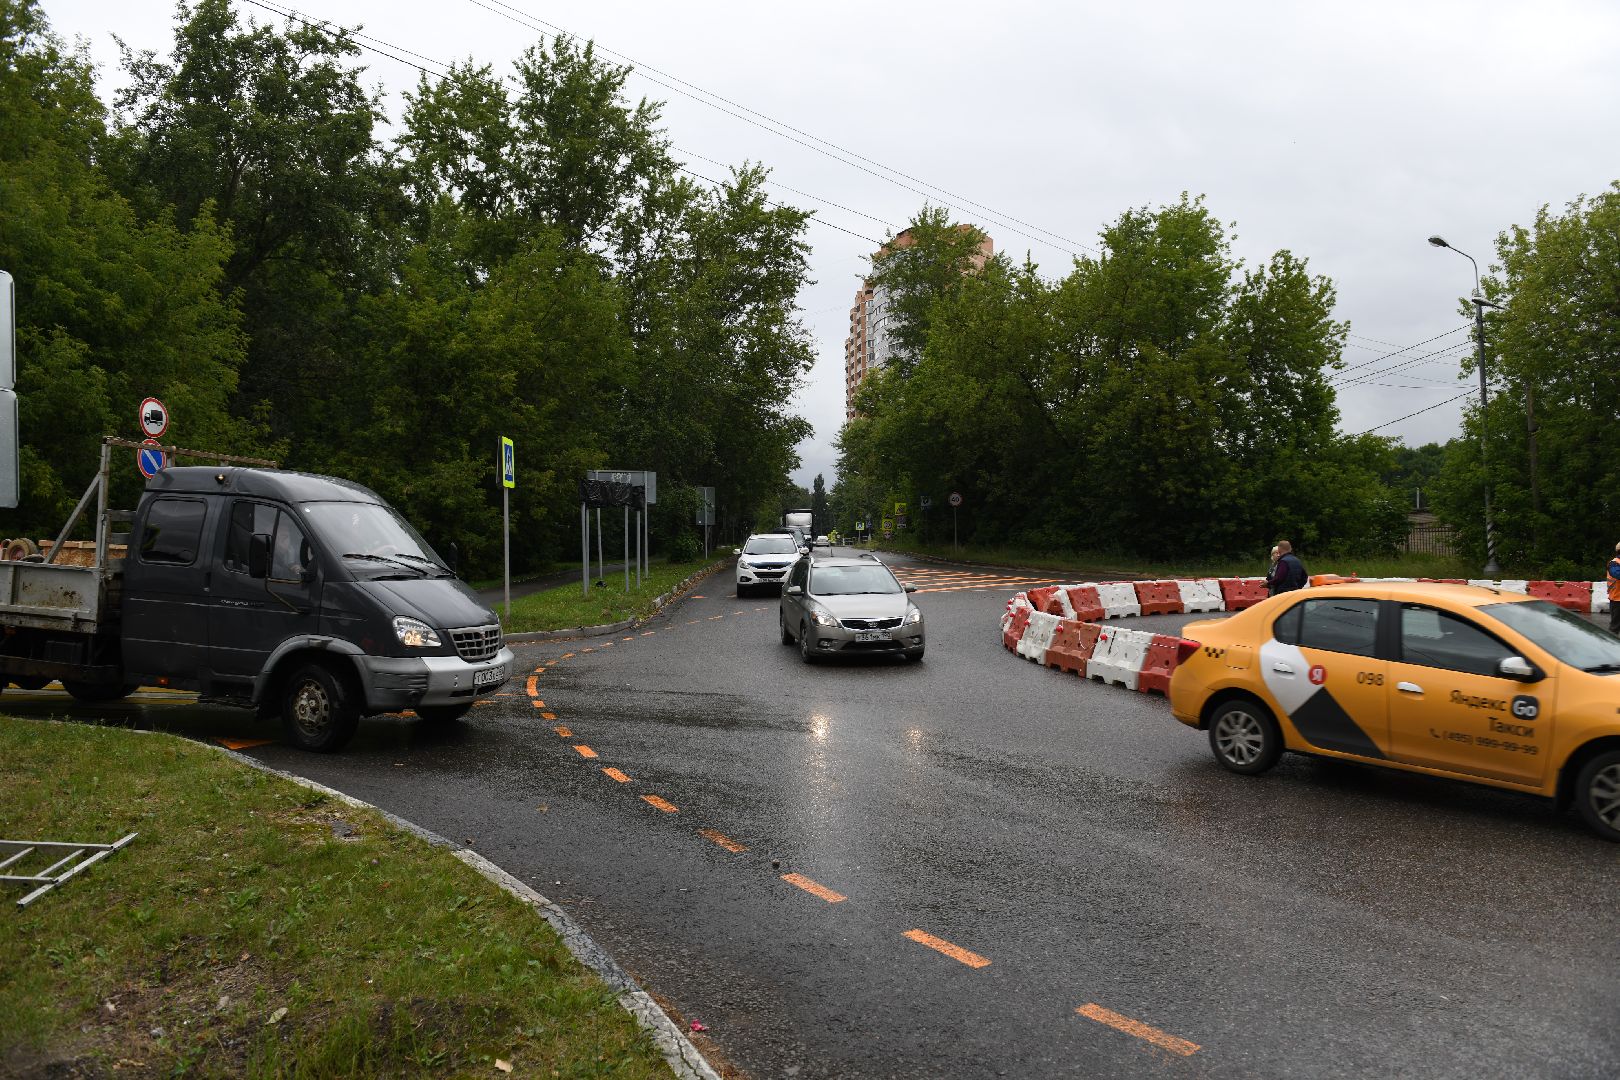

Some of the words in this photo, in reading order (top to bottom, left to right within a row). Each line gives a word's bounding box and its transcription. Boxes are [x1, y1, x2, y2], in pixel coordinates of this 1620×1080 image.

[1312, 668, 1323, 681] Я
[1357, 672, 1384, 686] 098
[1449, 689, 1507, 711] Яндекс
[1512, 700, 1537, 717] Go
[1488, 716, 1535, 738] Такси
[1442, 731, 1474, 745] (495)
[1476, 736, 1538, 755] 999-99-99
